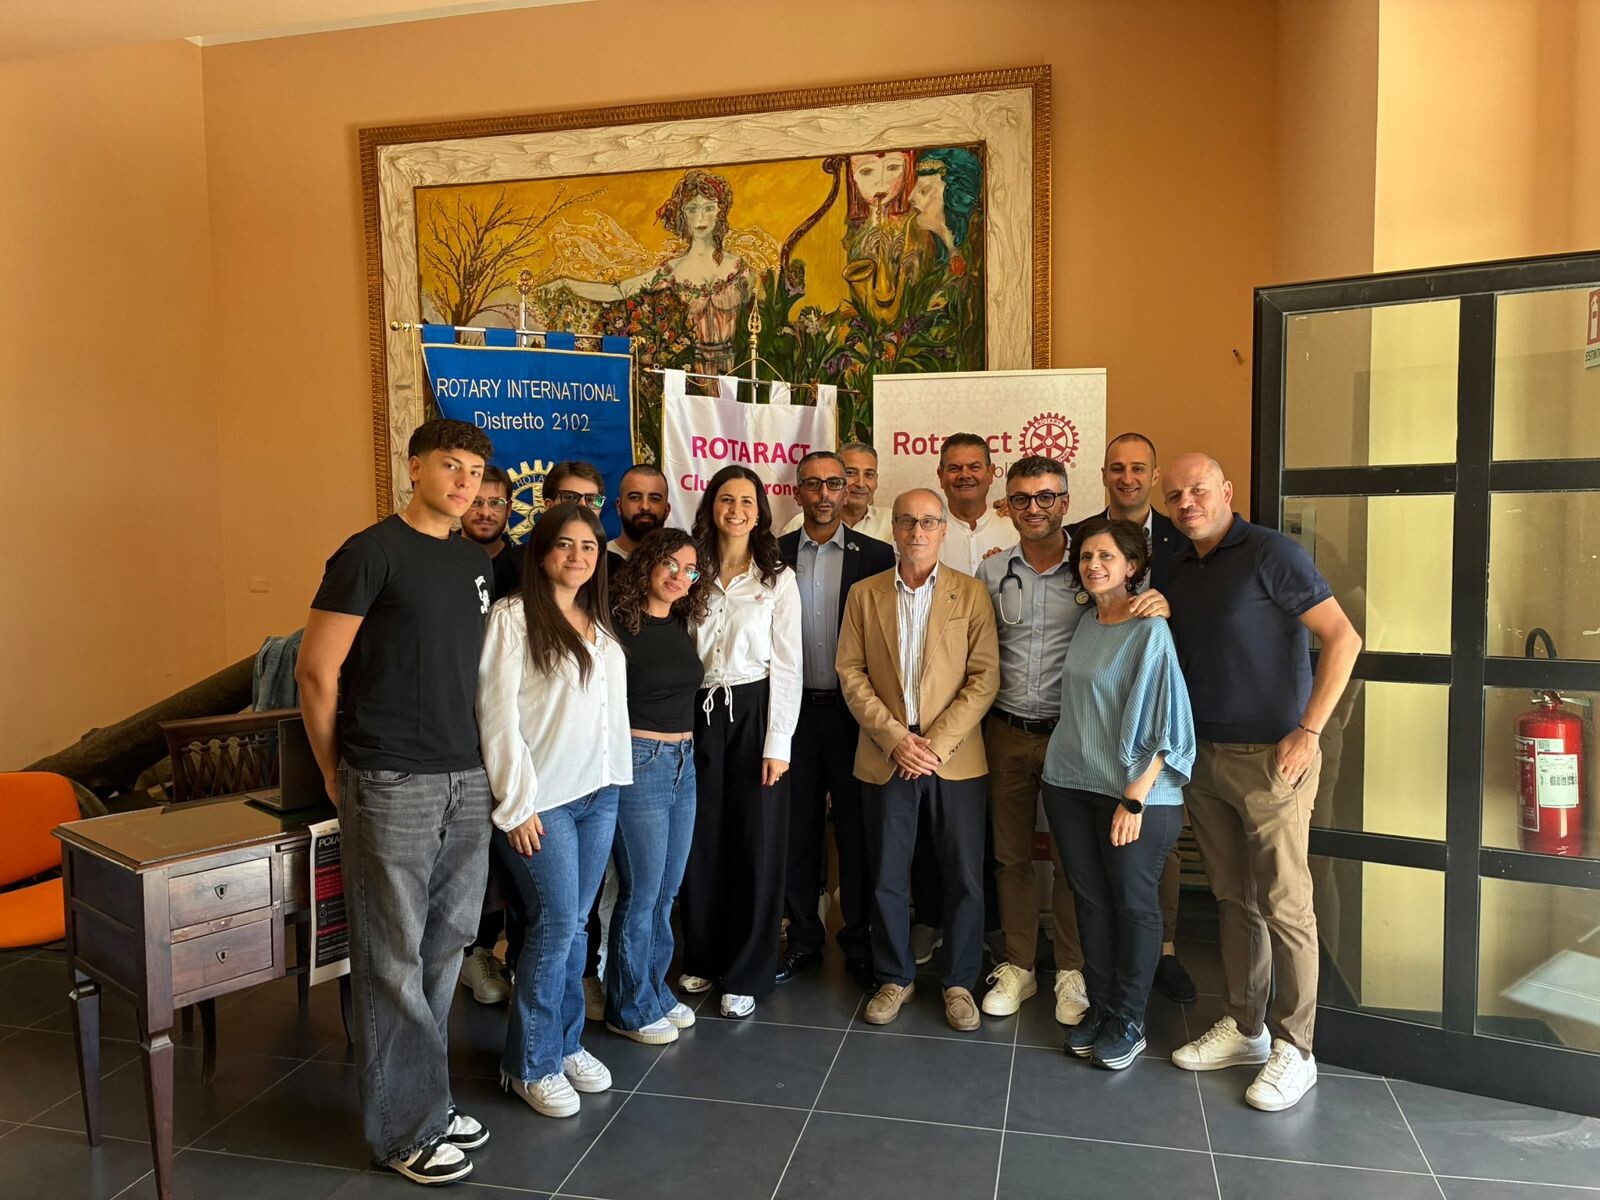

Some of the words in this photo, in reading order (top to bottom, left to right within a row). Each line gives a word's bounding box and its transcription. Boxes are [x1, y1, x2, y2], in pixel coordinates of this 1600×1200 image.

[436, 378, 501, 398] ROTARY
[507, 380, 620, 402] INTERNATIONAL
[474, 411, 545, 430] Distretto
[552, 412, 591, 432] 2102
[1036, 418, 1062, 426] ROTARY
[692, 436, 811, 465] ROTARACT
[893, 431, 1012, 455] Rotct
[515, 474, 546, 488] ROTA
[680, 473, 712, 492] Clu
